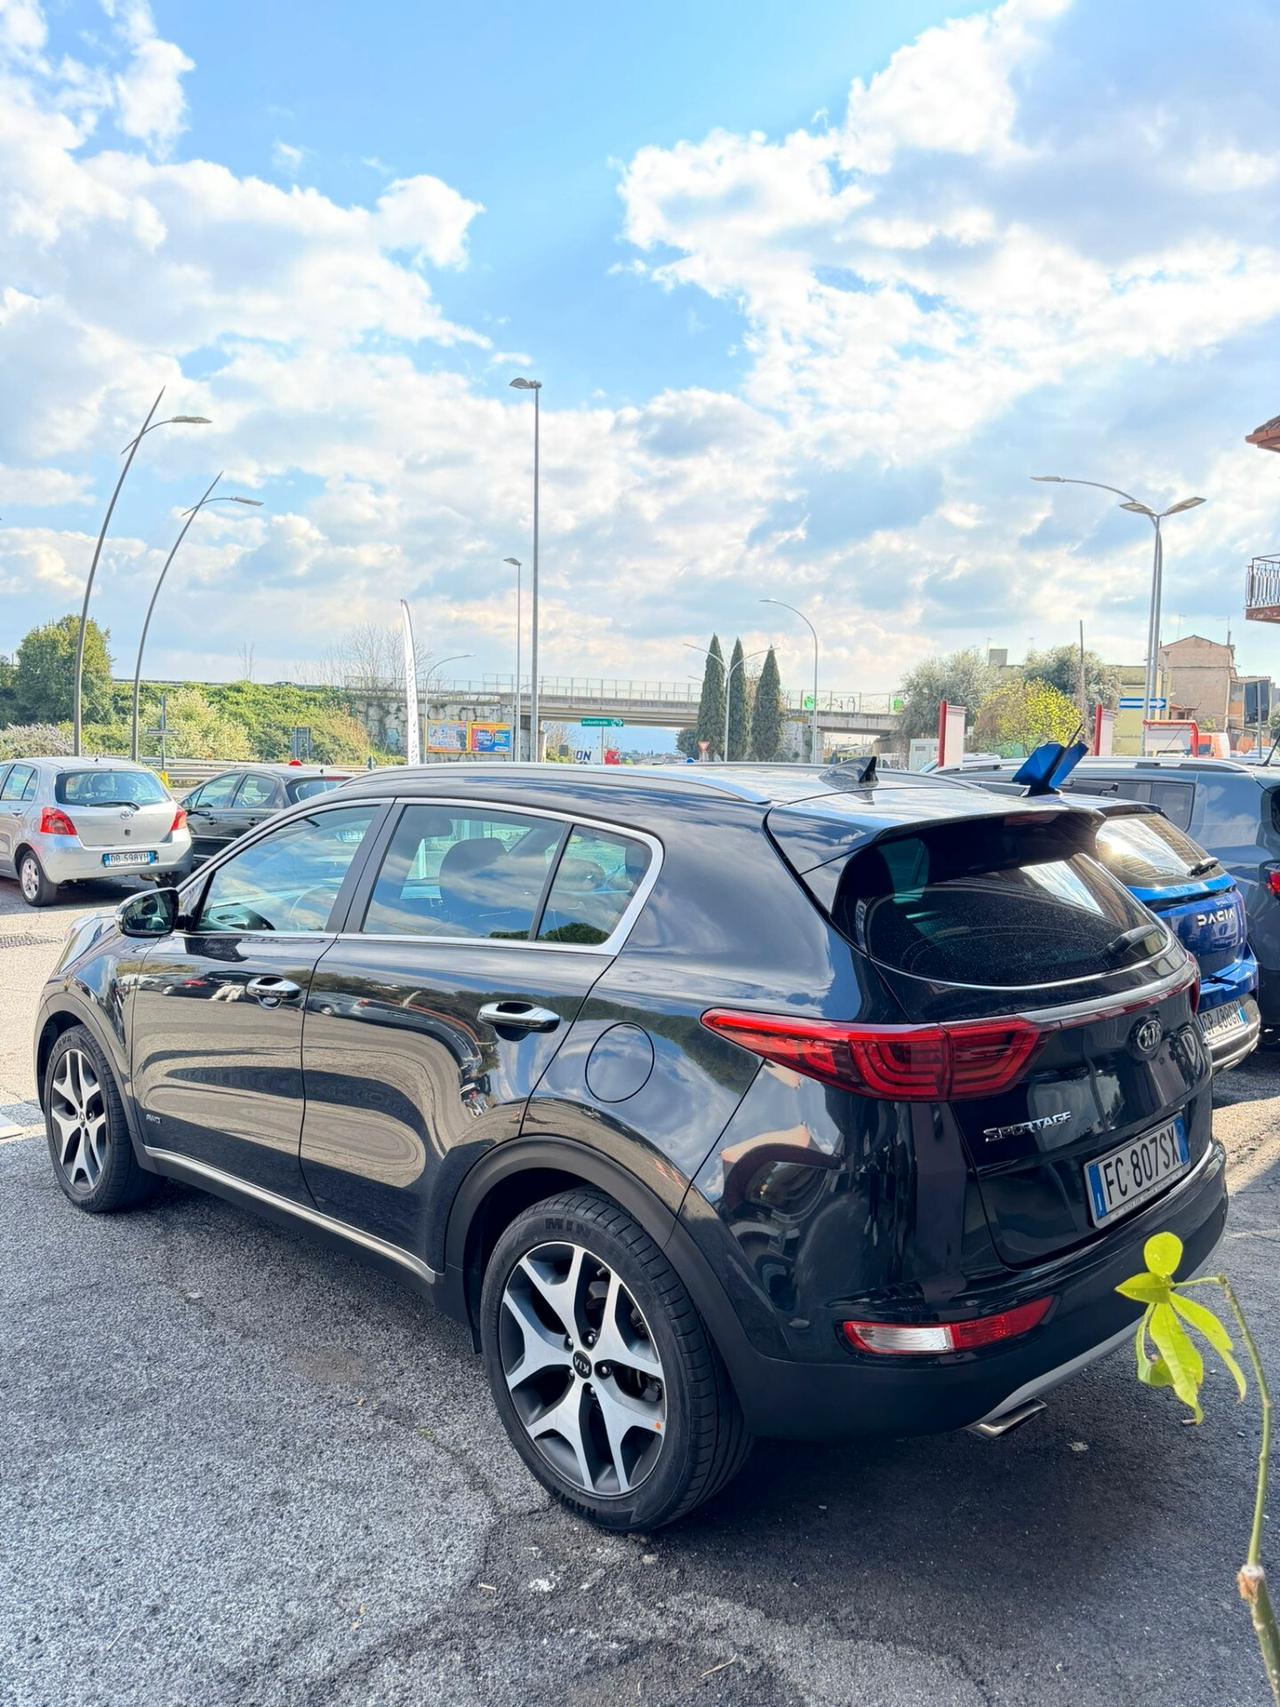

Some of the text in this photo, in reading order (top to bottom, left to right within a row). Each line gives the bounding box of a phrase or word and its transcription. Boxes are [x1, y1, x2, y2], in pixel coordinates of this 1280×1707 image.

[983, 1111, 1073, 1142] SPORTAGE
[1103, 1157, 1128, 1205] FC
[1130, 1126, 1180, 1188] 807SX
[574, 1356, 590, 1374] KIA
